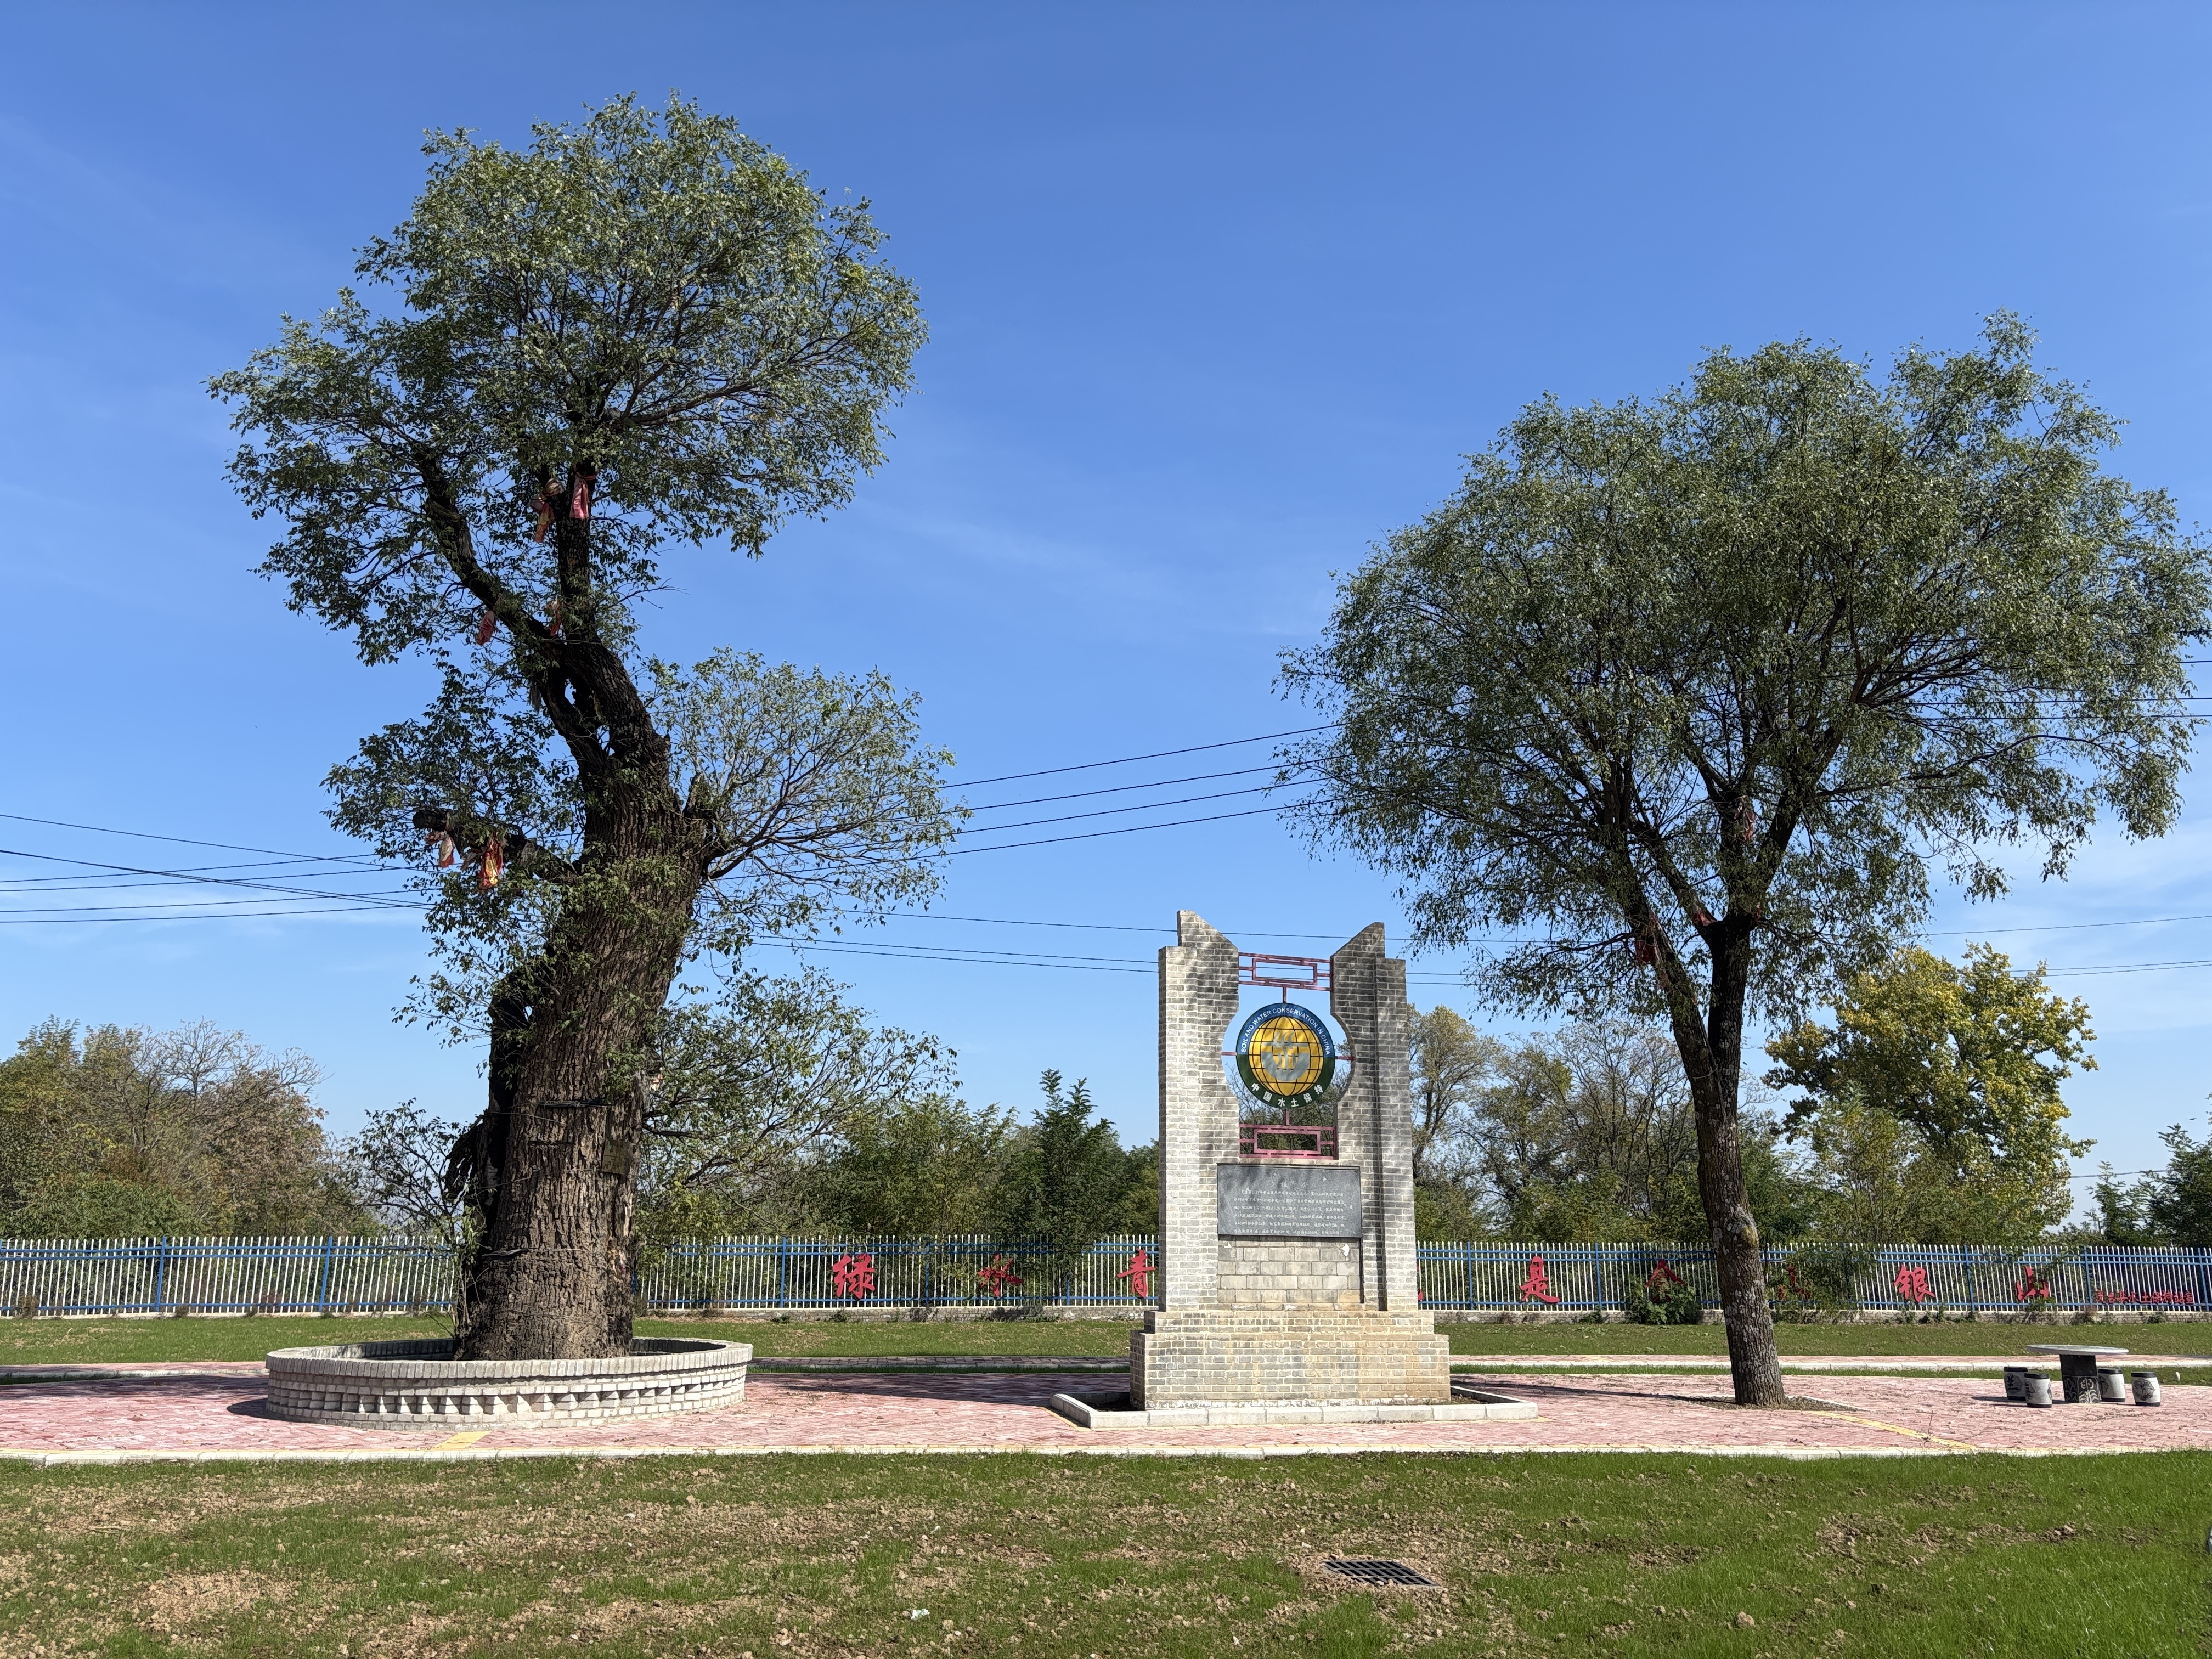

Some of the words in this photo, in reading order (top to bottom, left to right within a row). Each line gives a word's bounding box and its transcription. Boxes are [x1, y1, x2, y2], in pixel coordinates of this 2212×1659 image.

[1252, 1010, 1271, 1025] WATER
[1272, 1008, 1318, 1028] CONSERVATION
[1316, 1026, 1322, 1035] IN
[1321, 1034, 1330, 1055] CHINA
[1251, 1082, 1323, 1107] 中国水土保持
[832, 1253, 875, 1299] 绿
[978, 1252, 1024, 1297] 水
[1116, 1249, 1156, 1299] 青
[1520, 1256, 1560, 1302] 是
[1894, 1264, 1936, 1302] 银
[2016, 1266, 2049, 1301] 山
